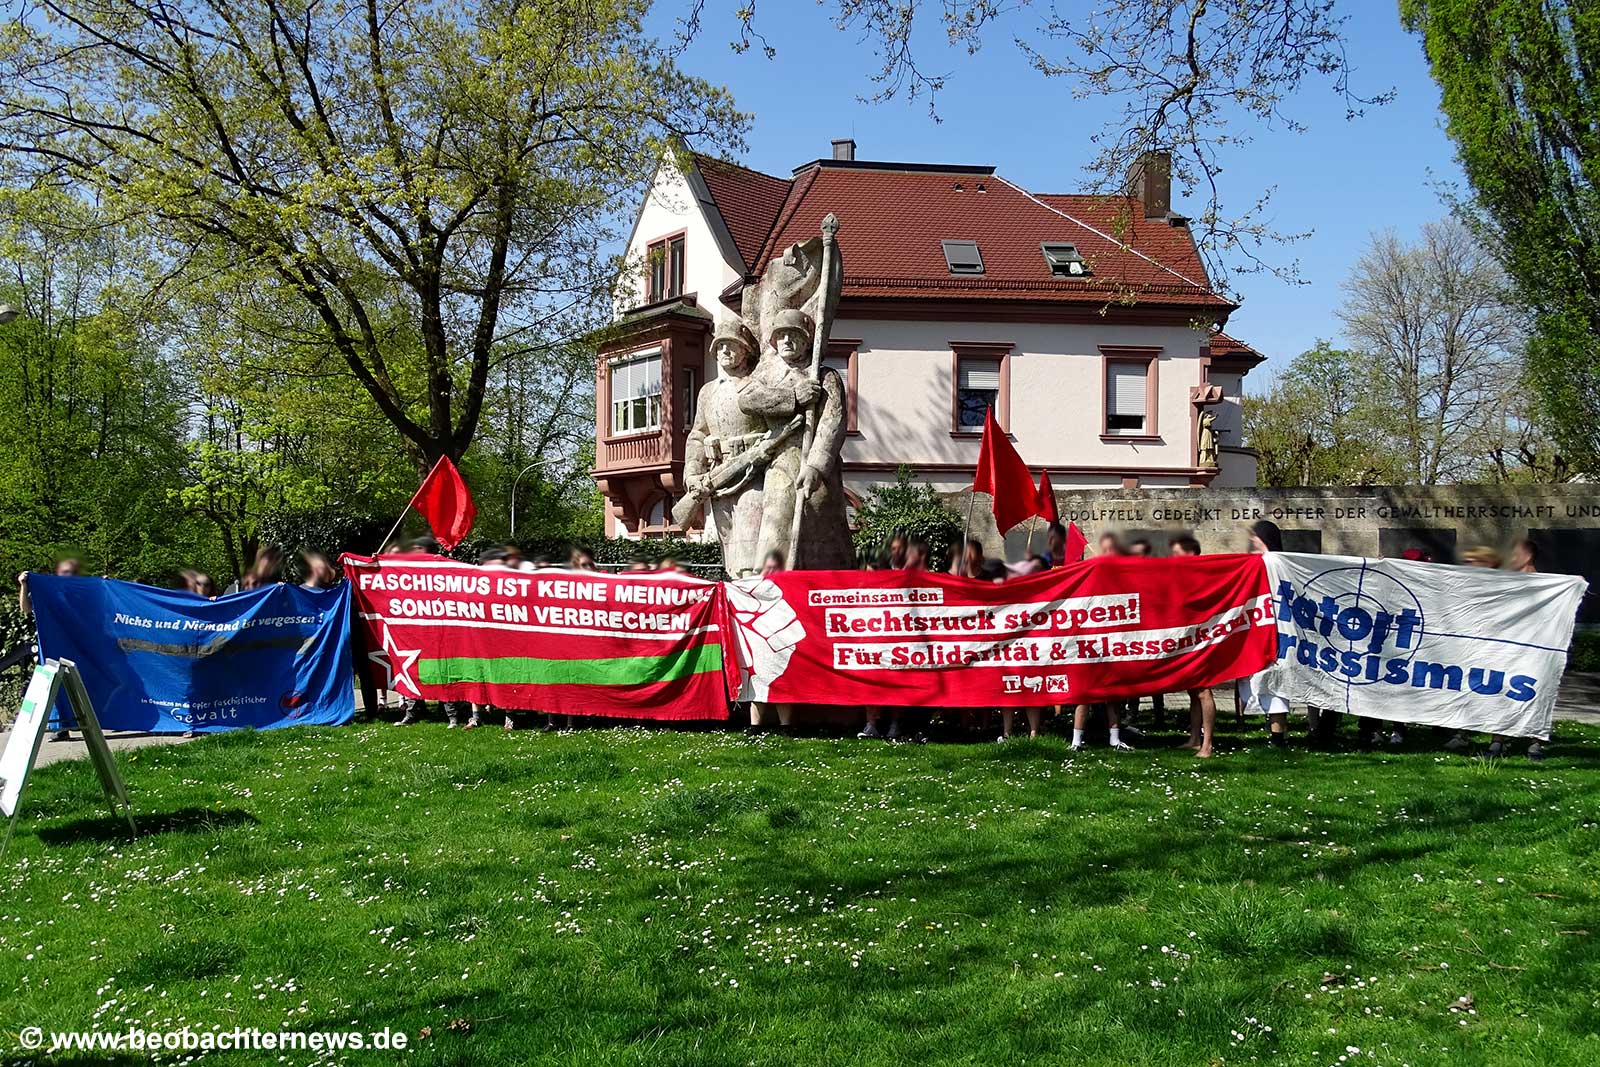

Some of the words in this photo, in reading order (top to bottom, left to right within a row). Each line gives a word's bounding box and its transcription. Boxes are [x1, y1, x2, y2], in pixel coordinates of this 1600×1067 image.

[1060, 509, 1143, 521] ADOLFZELL
[1152, 508, 1222, 521] GEDENKT
[1231, 508, 1262, 520] DER
[1272, 507, 1325, 520] OPFER
[1335, 507, 1367, 519] DER
[1377, 505, 1555, 519] GEWALTHERRSCHAFT
[1566, 505, 1600, 517] UND
[359, 573, 491, 596] FASCHISMUS
[496, 577, 532, 597] IST
[537, 580, 608, 602] KEINE
[810, 591, 904, 605] Gemeinsam
[908, 589, 939, 602] den
[114, 613, 153, 629] Nichts
[155, 619, 182, 630] und
[183, 619, 240, 632] Niemand
[241, 618, 256, 629] ist
[258, 615, 315, 628] vergessen
[389, 598, 486, 619] SONDERN
[491, 603, 529, 623] EIN
[535, 605, 691, 631] VERBRECHEN!
[829, 610, 996, 633] Rechtsruck
[1004, 598, 1137, 631] stoppen!
[1277, 579, 1421, 654] tatort
[837, 648, 882, 665] Für
[891, 642, 1040, 666] Solidarität
[1050, 642, 1067, 661] &
[1277, 632, 1537, 702] rassismus
[170, 707, 238, 723] Gewalt
